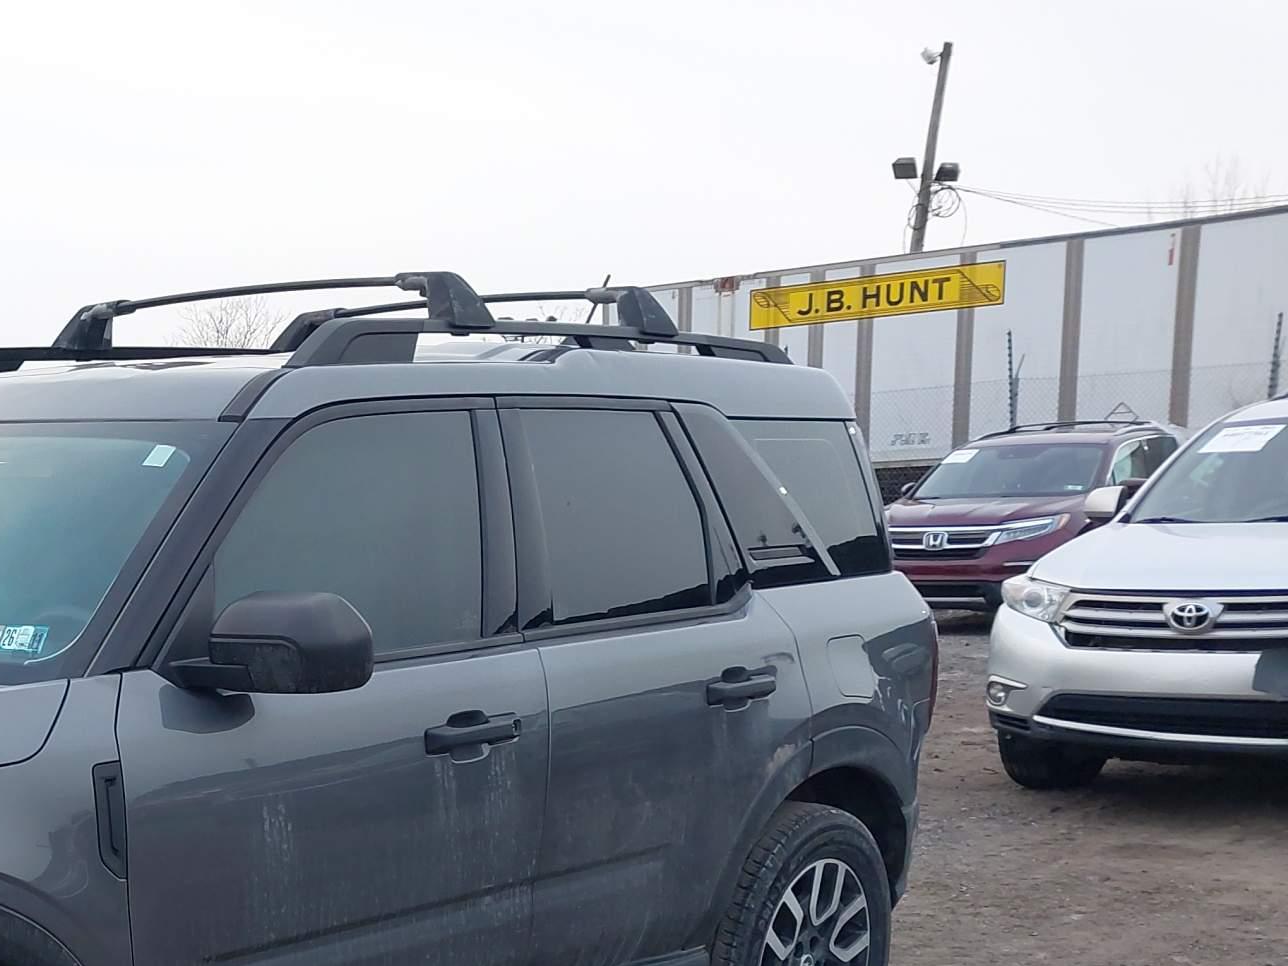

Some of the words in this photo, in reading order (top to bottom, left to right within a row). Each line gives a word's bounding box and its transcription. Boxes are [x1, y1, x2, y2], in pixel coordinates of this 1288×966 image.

[796, 289, 852, 316] J.B.
[862, 276, 952, 309] HUNT
[2, 628, 17, 647] 26
